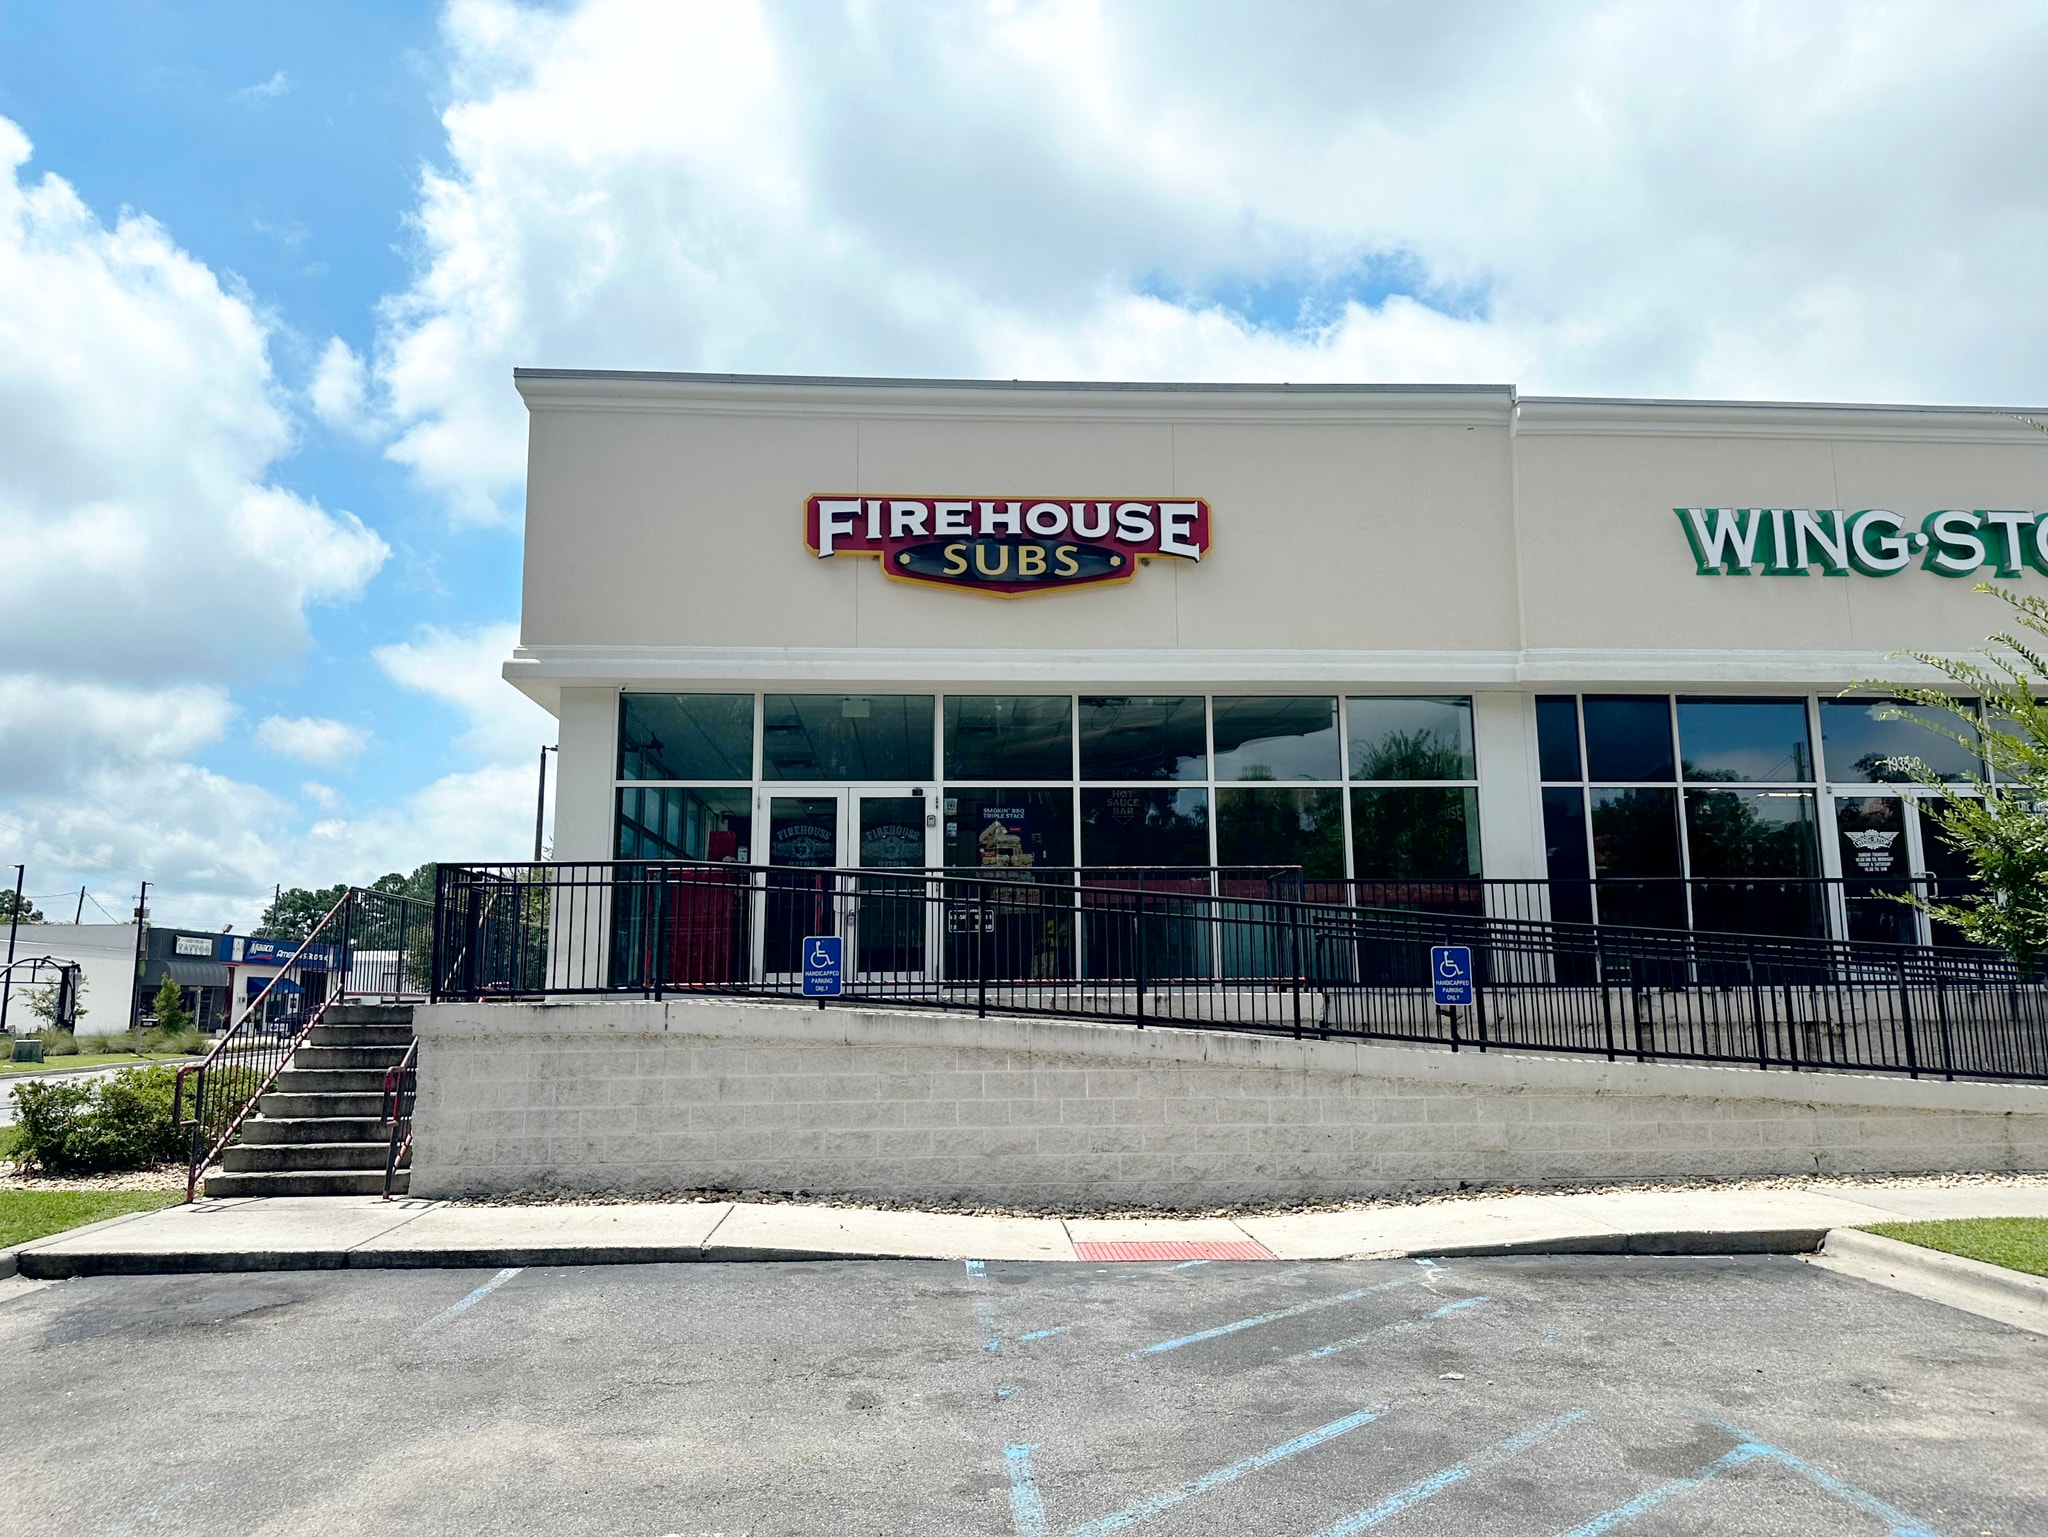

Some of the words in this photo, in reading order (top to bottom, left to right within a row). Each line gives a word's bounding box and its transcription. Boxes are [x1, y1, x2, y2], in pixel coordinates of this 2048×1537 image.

[817, 498, 1201, 563] FIREHOUSE
[943, 544, 1079, 577] SUBS
[1112, 790, 1134, 798] HOT
[1107, 798, 1139, 806] SAUCE
[776, 826, 832, 840] FIREHOUSE
[866, 826, 920, 841] FIREHOUSE
